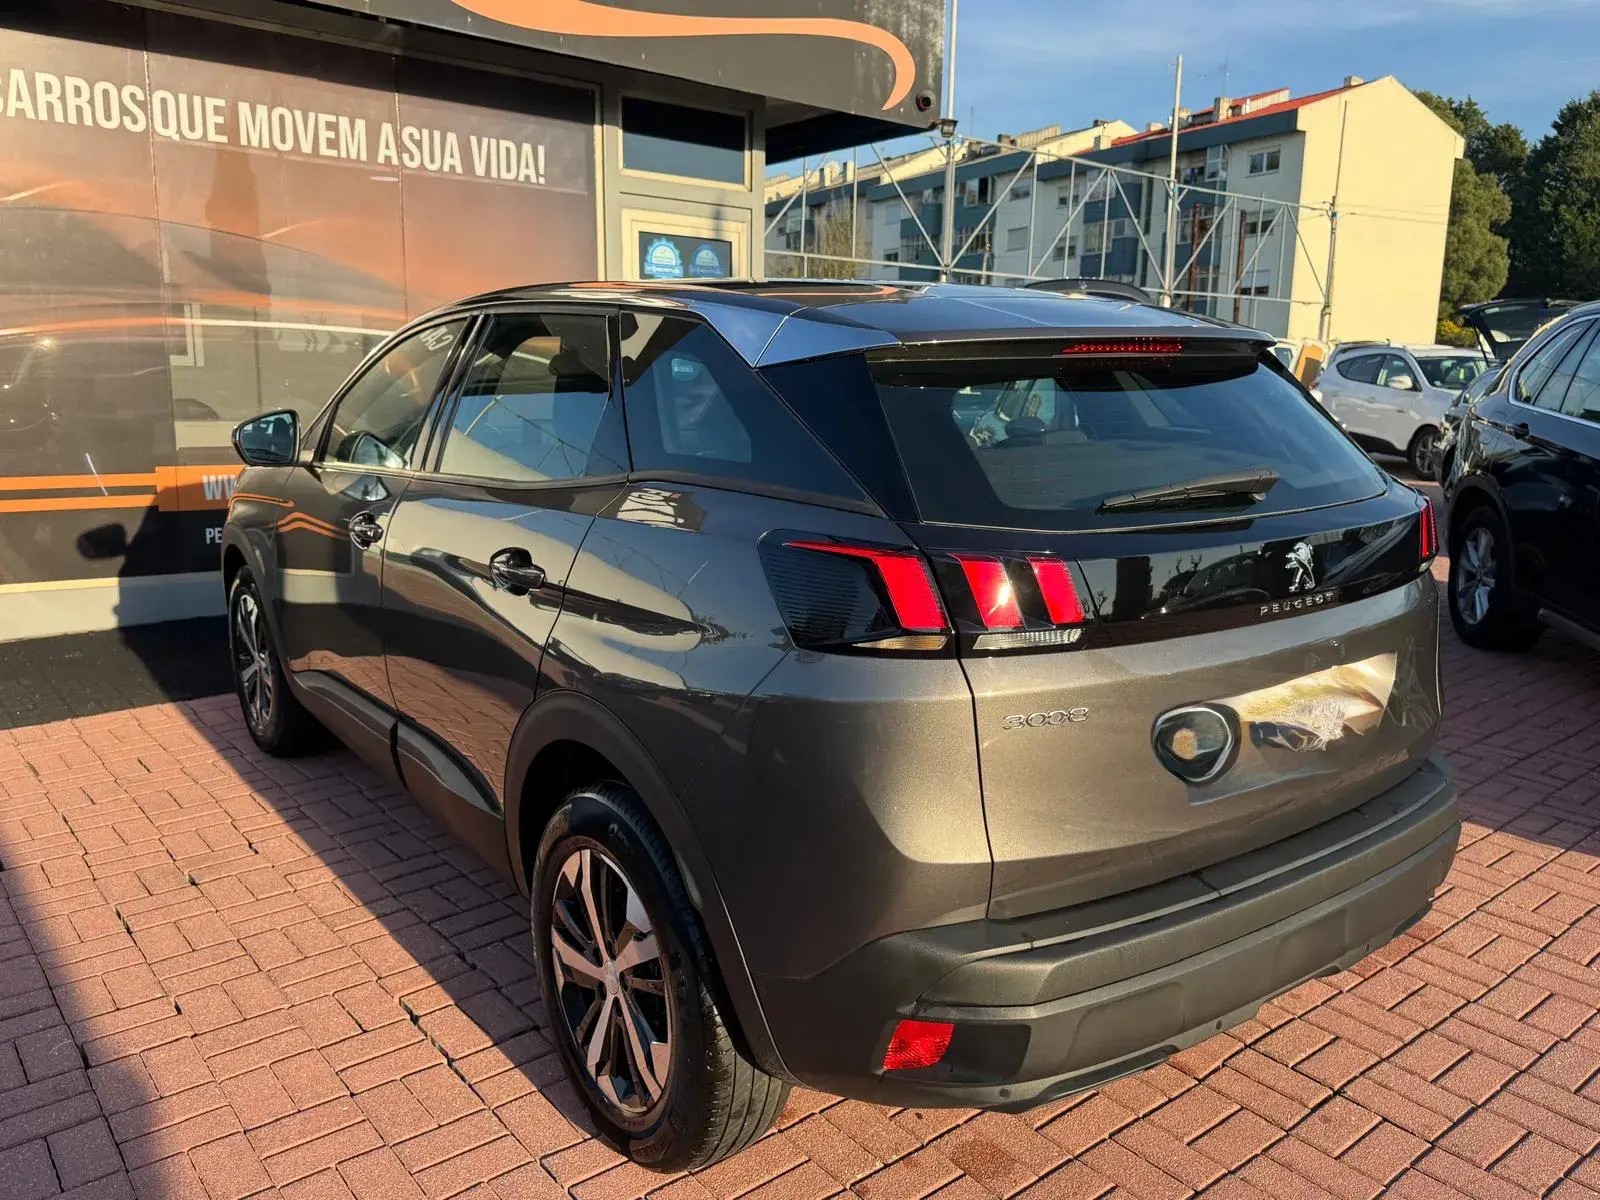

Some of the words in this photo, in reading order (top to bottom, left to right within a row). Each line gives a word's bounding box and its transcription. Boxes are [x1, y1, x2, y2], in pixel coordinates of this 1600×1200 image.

[0, 68, 148, 133] ARROS
[152, 89, 228, 142] QUE
[238, 101, 367, 161] MOVEM
[377, 122, 399, 166] A
[401, 126, 463, 174] SUA
[470, 135, 545, 185] VIDA!
[1260, 591, 1334, 616] PEUGEOT
[1002, 707, 1089, 730] 3008
